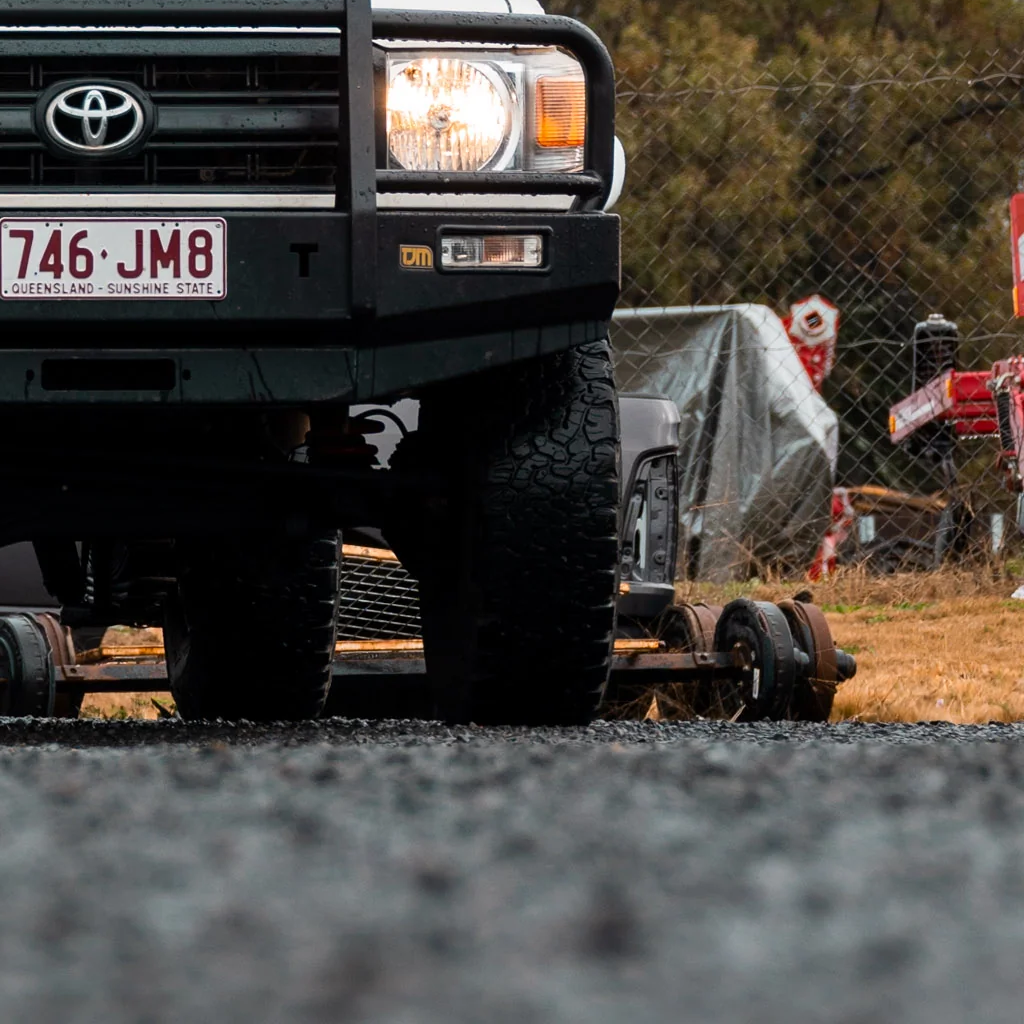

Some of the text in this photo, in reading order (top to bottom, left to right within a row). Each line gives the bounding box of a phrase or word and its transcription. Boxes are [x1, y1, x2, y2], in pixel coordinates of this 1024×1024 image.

[11, 283, 94, 295] QUEENSLAND
[107, 283, 169, 294] SUNSHINE
[176, 283, 213, 294] STATE
